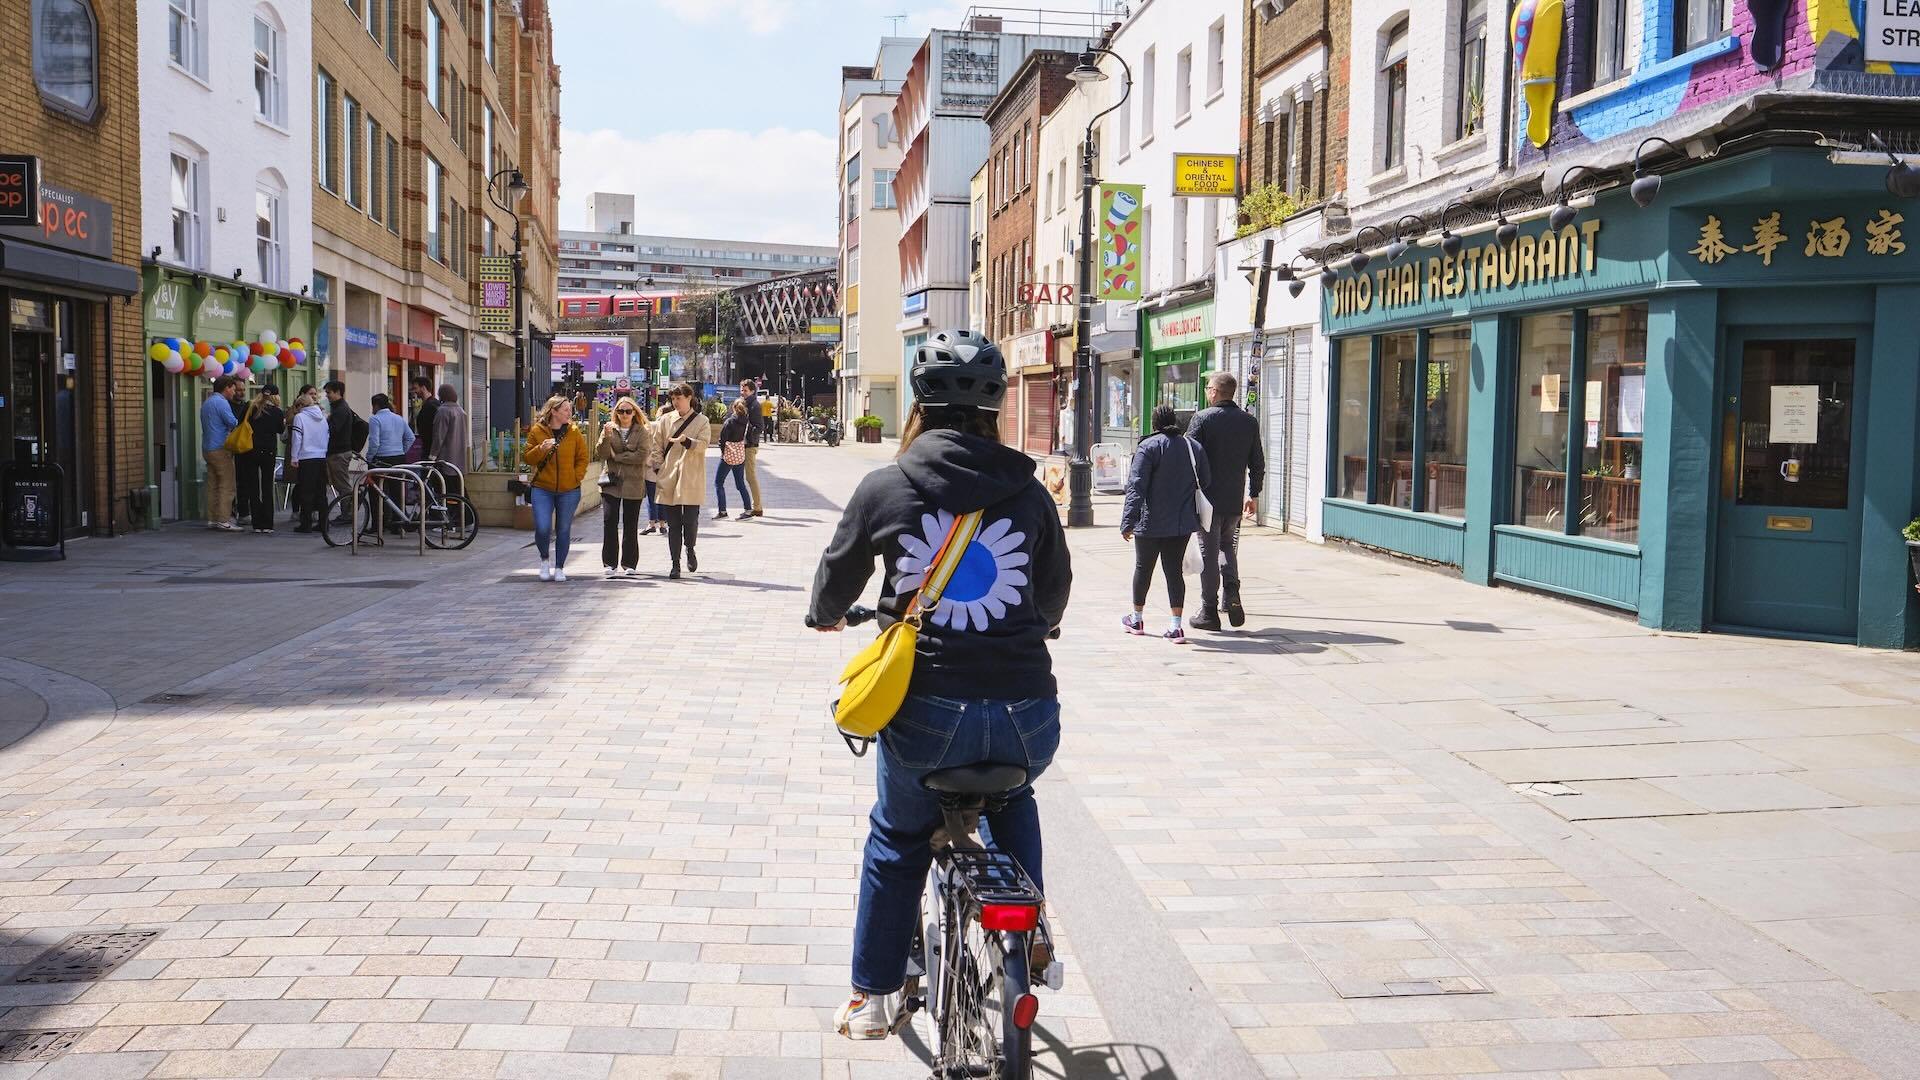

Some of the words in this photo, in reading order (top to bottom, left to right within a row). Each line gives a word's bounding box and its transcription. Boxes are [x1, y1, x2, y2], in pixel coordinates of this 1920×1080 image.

[1882, 28, 1920, 46] STR
[1187, 160, 1224, 168] CHINESE
[40, 187, 74, 205] SPECIALIST
[1331, 272, 1372, 317] SINO
[1376, 260, 1421, 306] THAI
[1427, 218, 1600, 299] RESTAURANT
[485, 283, 505, 291] LOWER
[485, 290, 505, 298] MARSH
[1018, 283, 1074, 305] BAR
[485, 298, 505, 306] MARKET
[26, 499, 36, 518] RIOT
